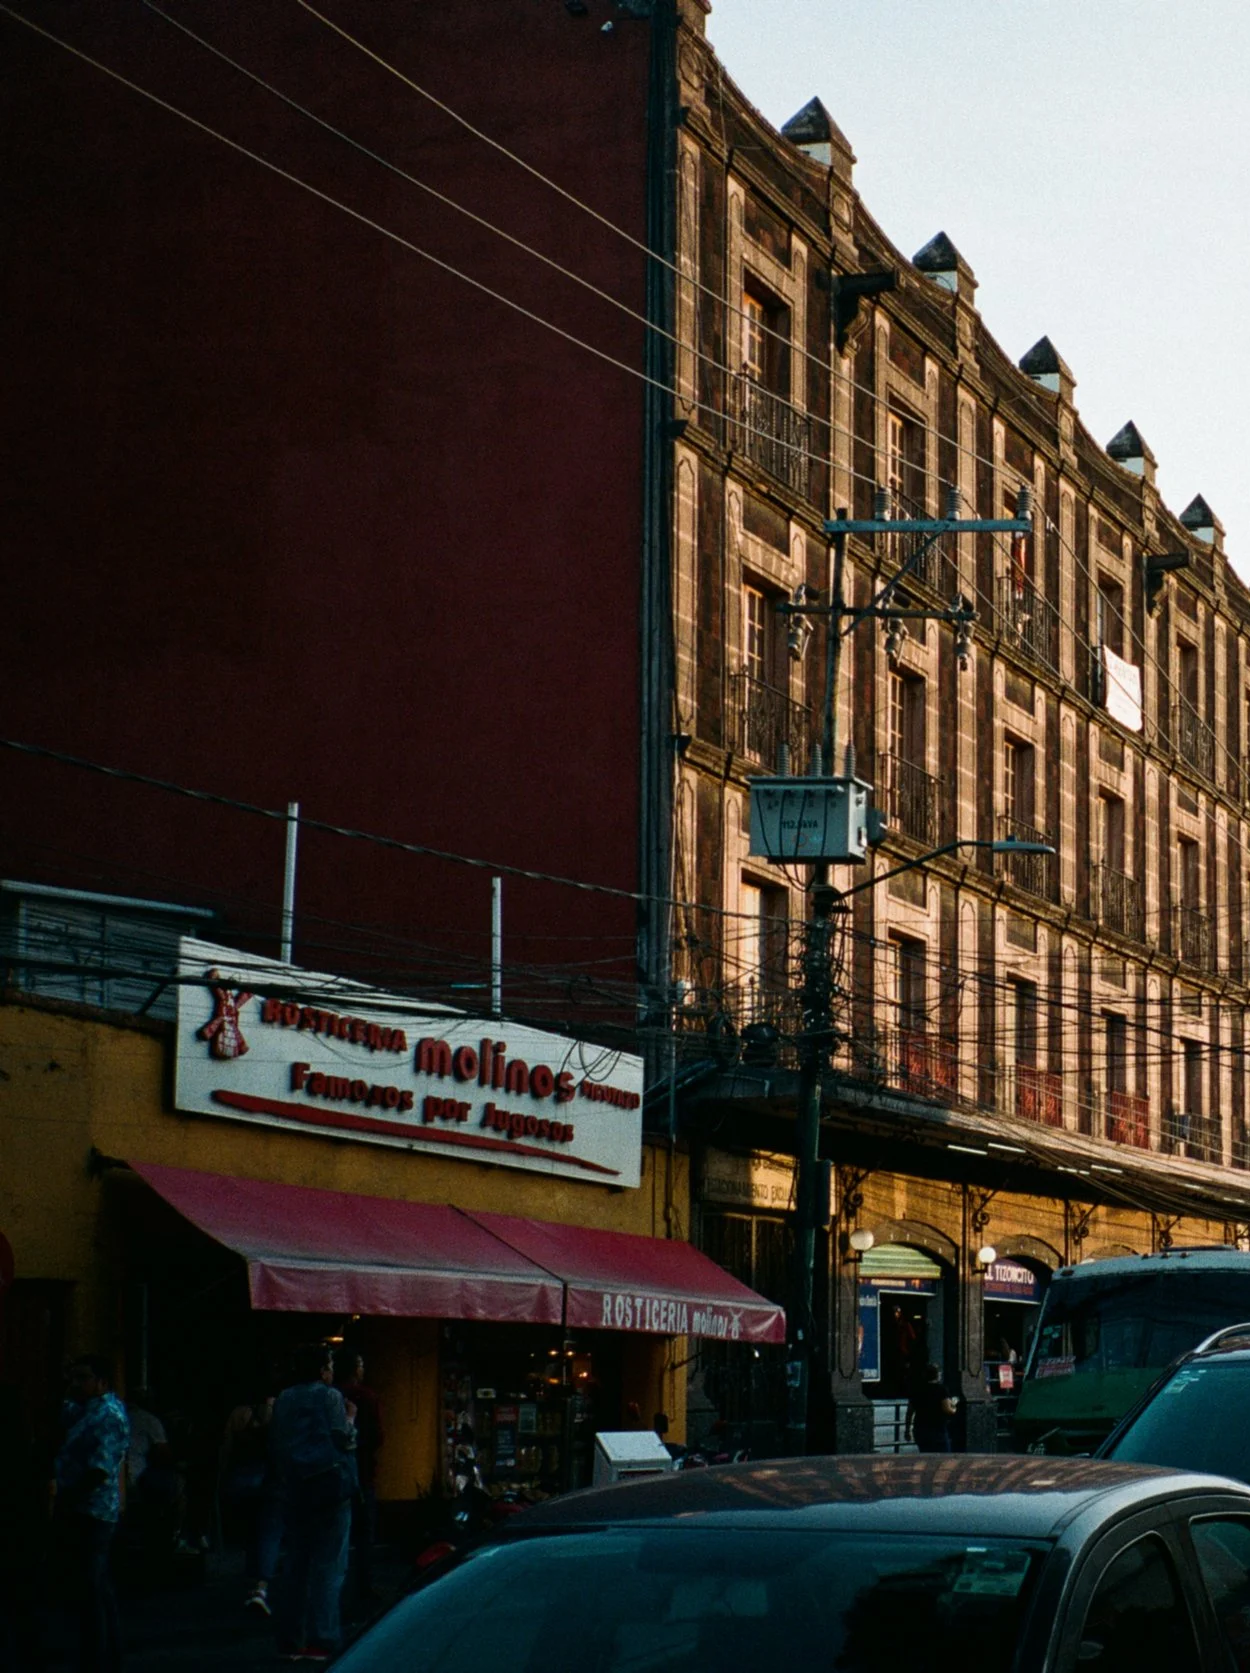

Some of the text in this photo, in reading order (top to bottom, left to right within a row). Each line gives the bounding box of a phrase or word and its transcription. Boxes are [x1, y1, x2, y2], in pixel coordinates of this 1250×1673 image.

[261, 998, 408, 1053] ROSTICERIA
[416, 1038, 576, 1102] molinos
[291, 1062, 574, 1143] Famosos por Jugosos
[601, 1293, 689, 1333] ROSTICERIA
